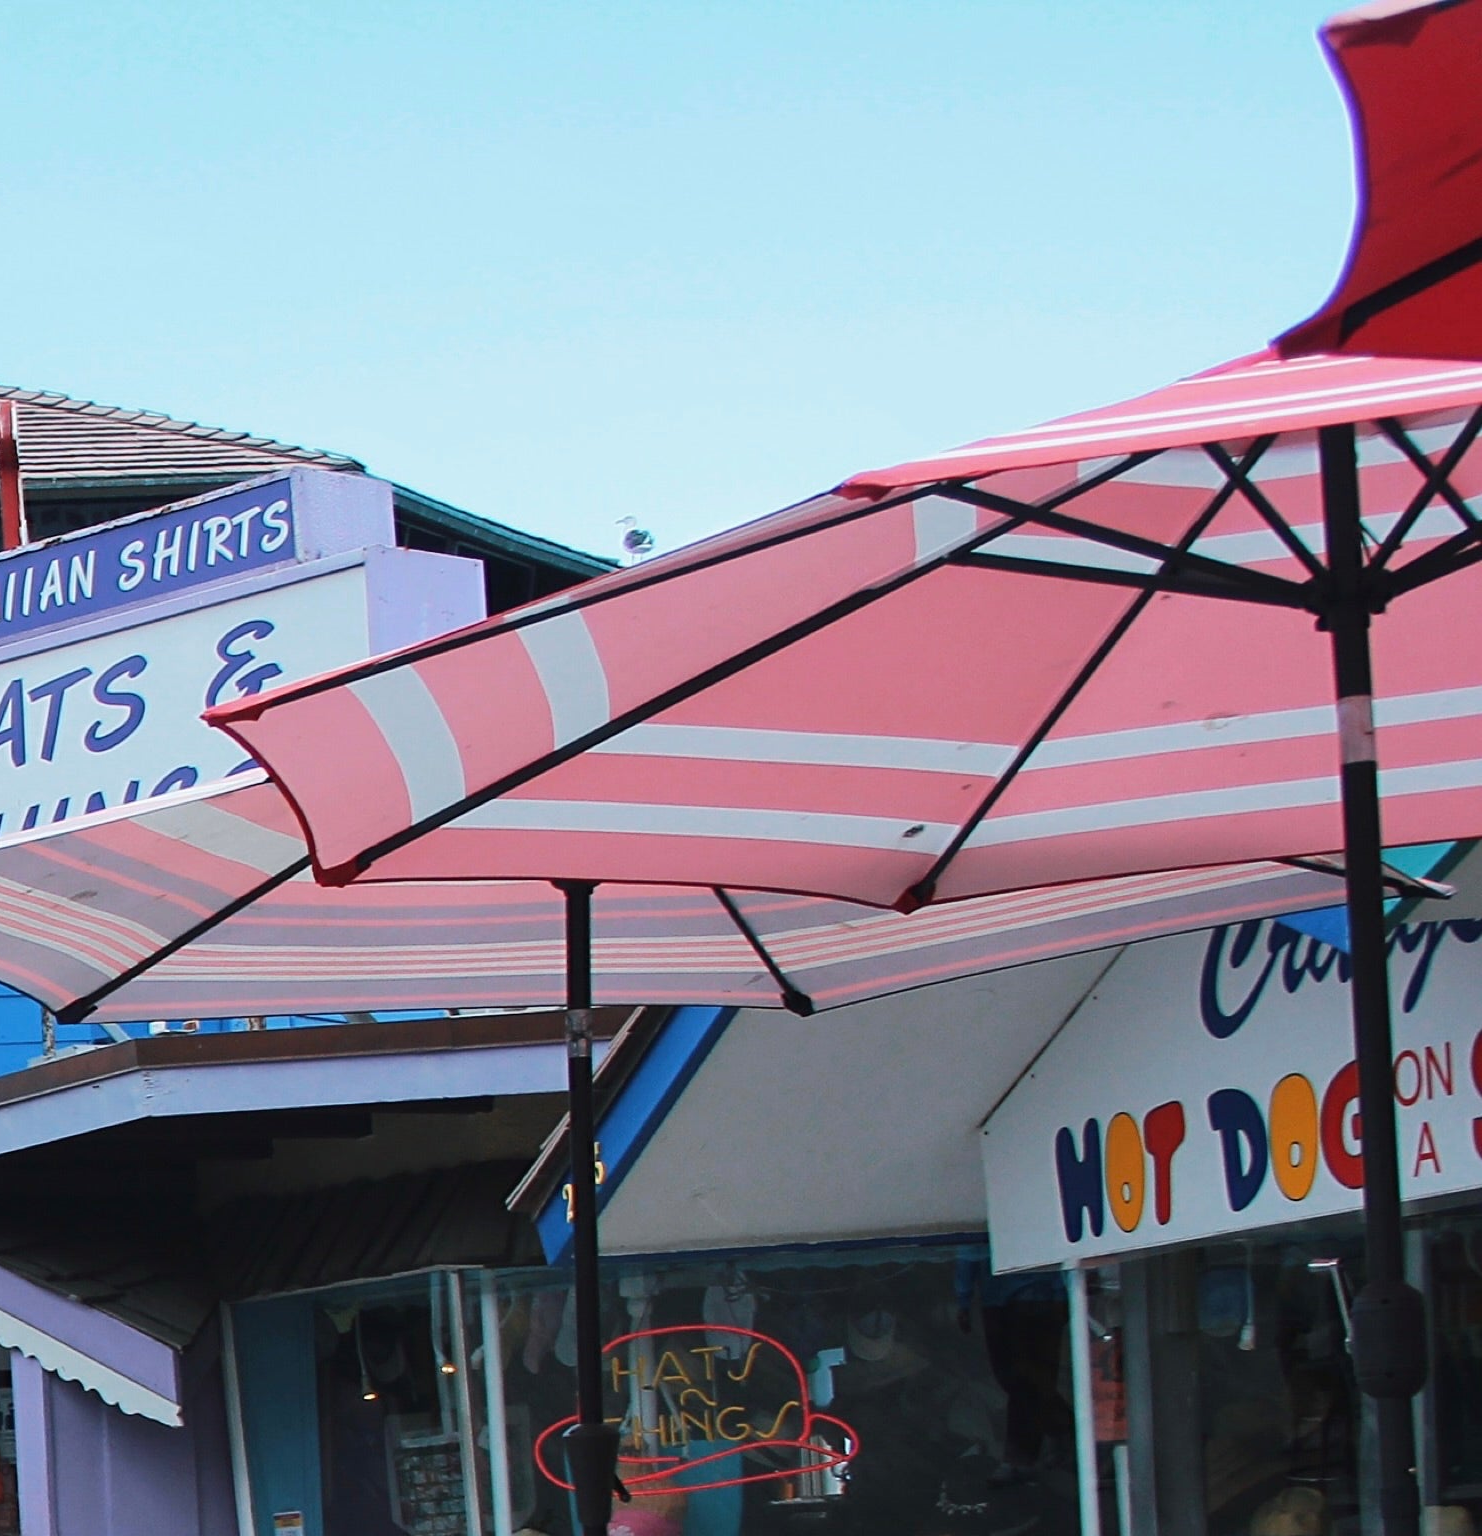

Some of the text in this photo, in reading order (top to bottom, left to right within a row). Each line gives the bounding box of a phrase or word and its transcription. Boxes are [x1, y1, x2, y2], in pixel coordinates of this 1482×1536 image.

[117, 500, 292, 592] SHIRTS
[204, 619, 285, 707] &
[1392, 1041, 1454, 1107] ON
[1055, 1100, 1186, 1243] HOT
[1413, 1121, 1442, 1178] A
[611, 1342, 764, 1393] HATS
